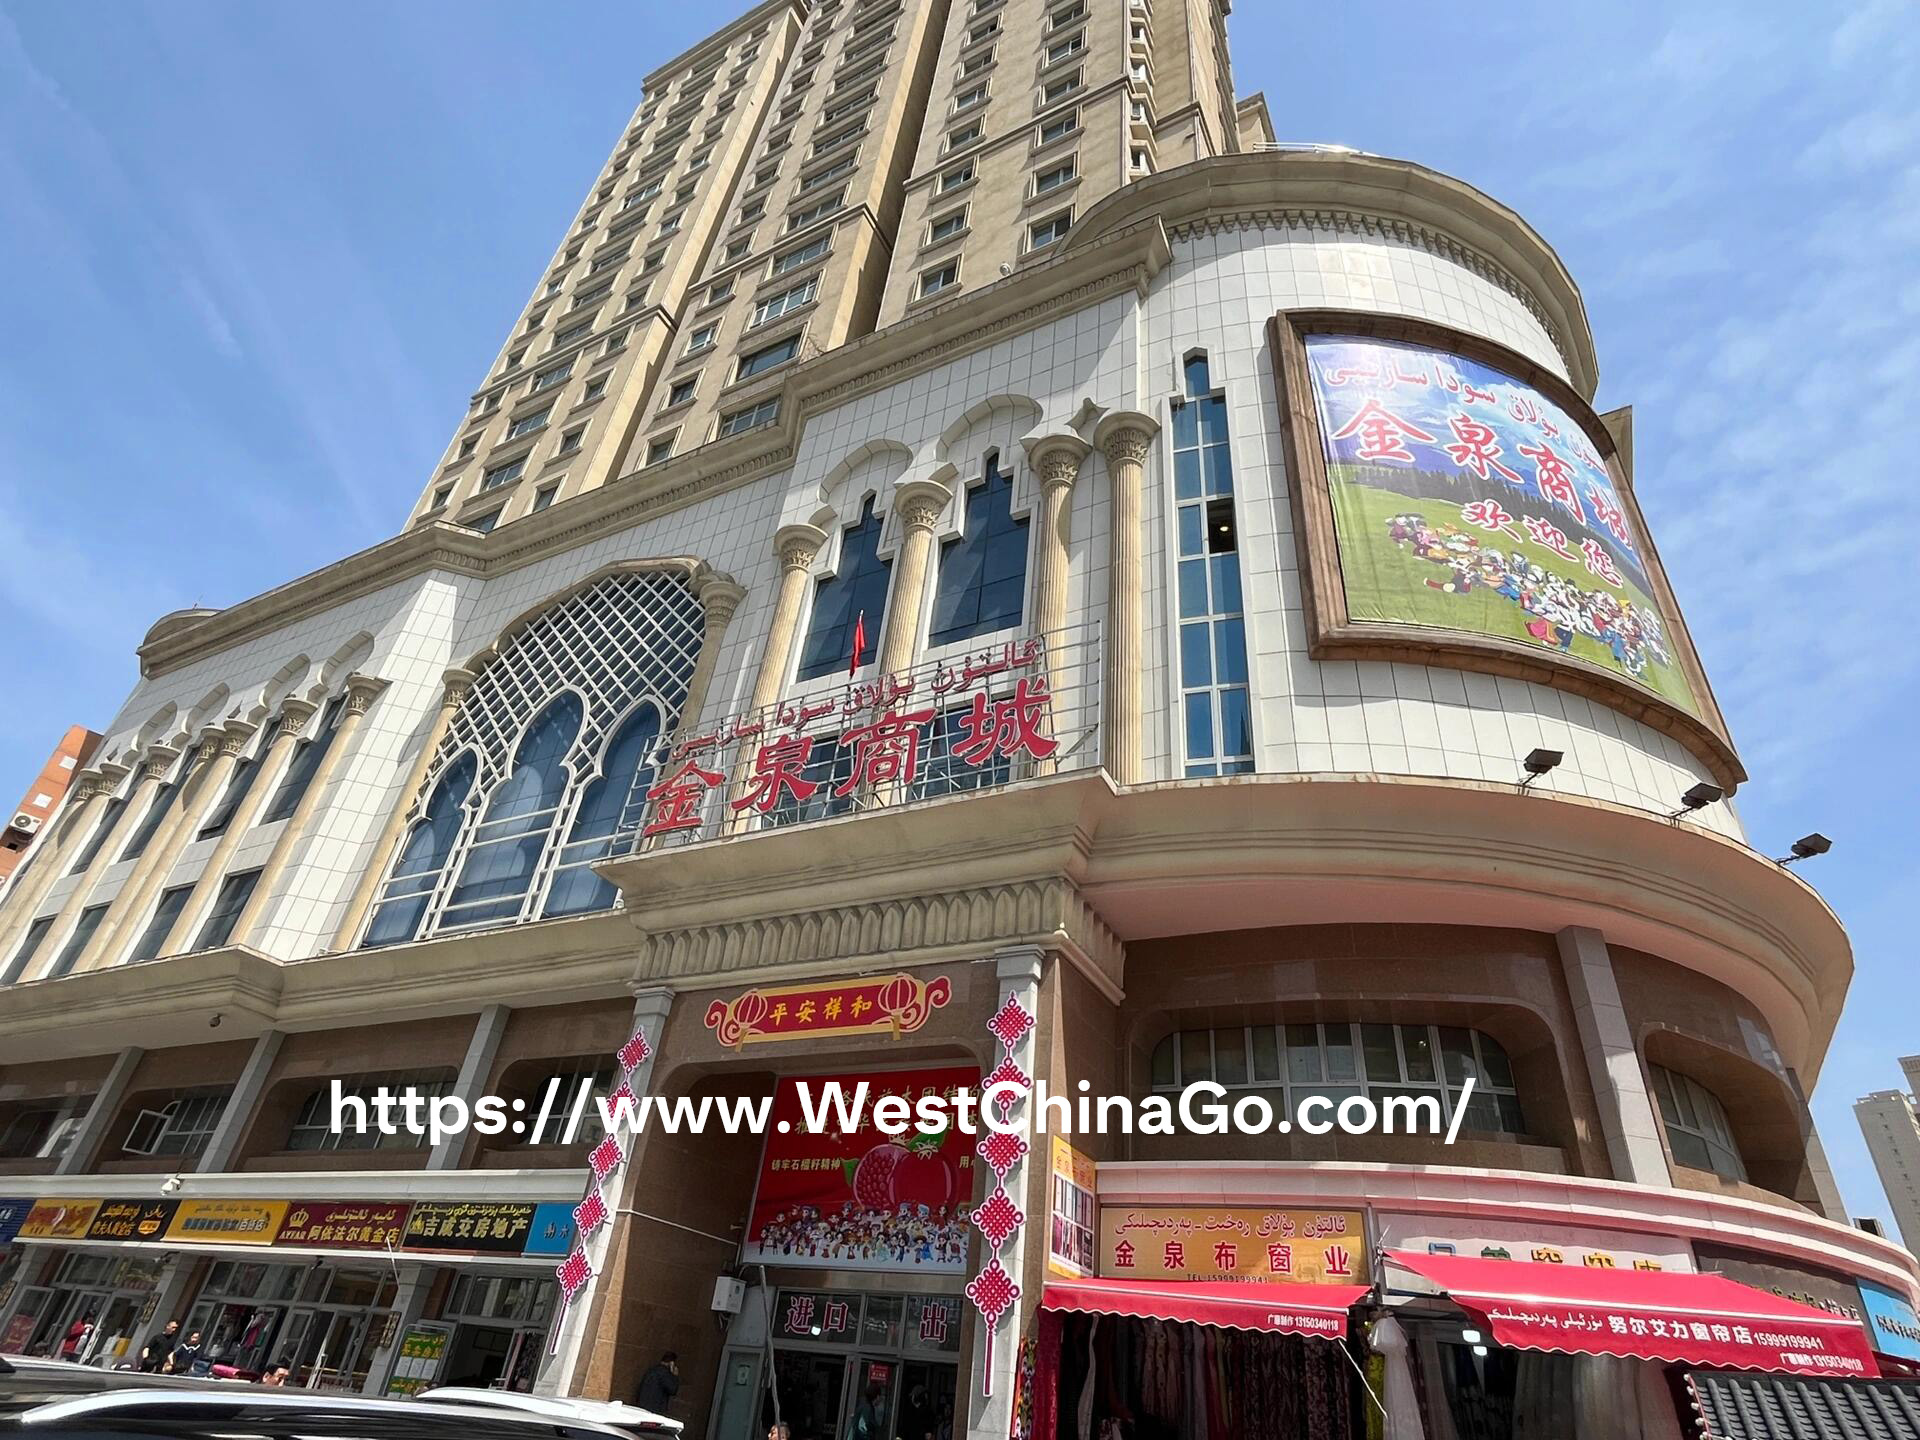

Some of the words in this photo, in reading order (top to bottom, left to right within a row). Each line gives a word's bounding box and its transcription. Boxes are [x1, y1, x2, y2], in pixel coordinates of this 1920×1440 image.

[1332, 398, 1633, 551] 金泉商城
[1461, 499, 1624, 589] 欢迎您
[776, 695, 837, 731] سودا
[643, 677, 1062, 837] 金泉商城
[769, 994, 873, 1026] 平安祥和
[307, 1225, 400, 1243] 阿依法尔黄金店
[1256, 1213, 1295, 1239] بۇلاق
[1302, 1214, 1346, 1240] ئالتۇن
[1114, 1239, 1351, 1276] 金泉布窗业
[784, 1295, 848, 1334] 进口
[919, 1302, 948, 1343] 出
[1295, 1315, 1339, 1331] 13150340118
[1608, 1315, 1753, 1345] 努尔艾力窗帘店
[1754, 1331, 1824, 1350] 15999199941
[1812, 1355, 1864, 1371] 13150340118
